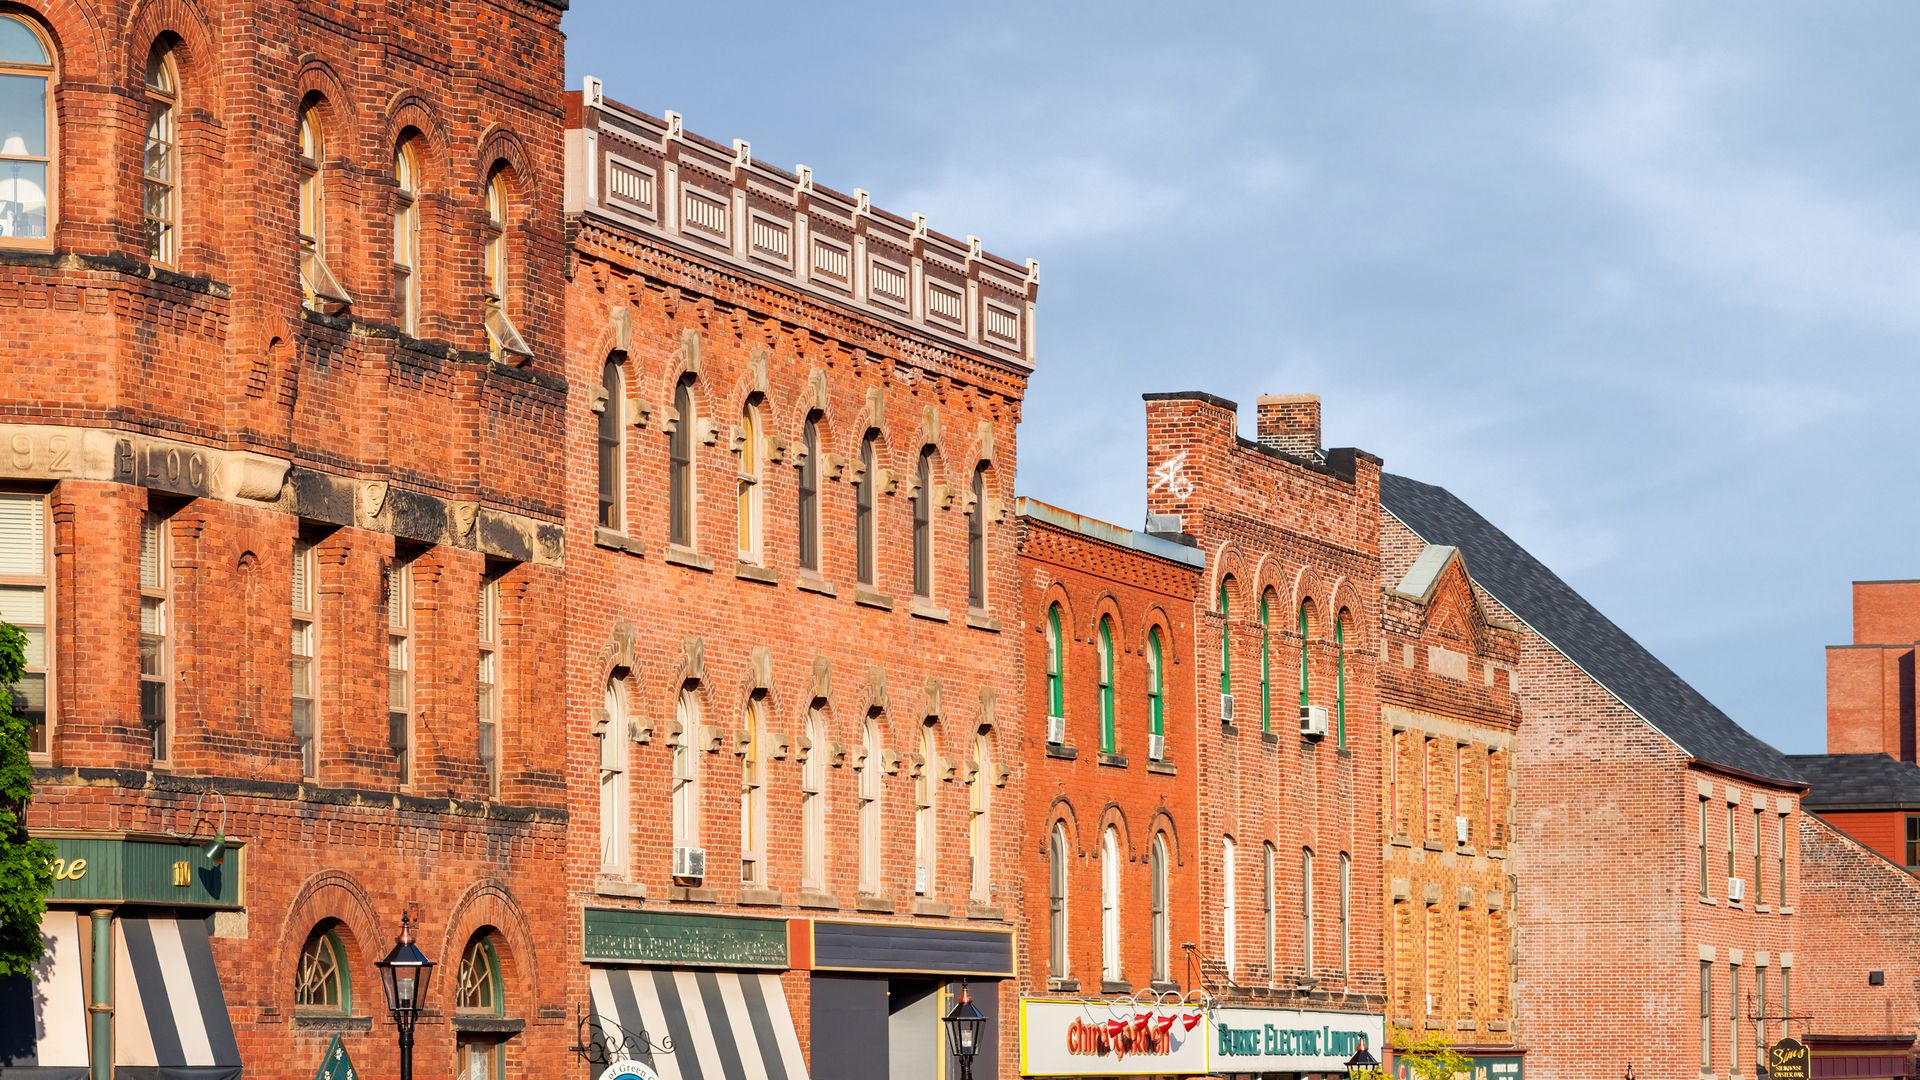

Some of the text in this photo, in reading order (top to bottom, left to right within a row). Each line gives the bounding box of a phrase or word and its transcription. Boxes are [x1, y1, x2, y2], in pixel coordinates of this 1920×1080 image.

[119, 438, 226, 493] BLOCK
[44, 858, 88, 881] ne
[1218, 1023, 1262, 1057] BURKE
[1264, 1024, 1321, 1057] ELECTRIC
[1771, 1048, 1805, 1067] Sims
[619, 1064, 647, 1078] Green
